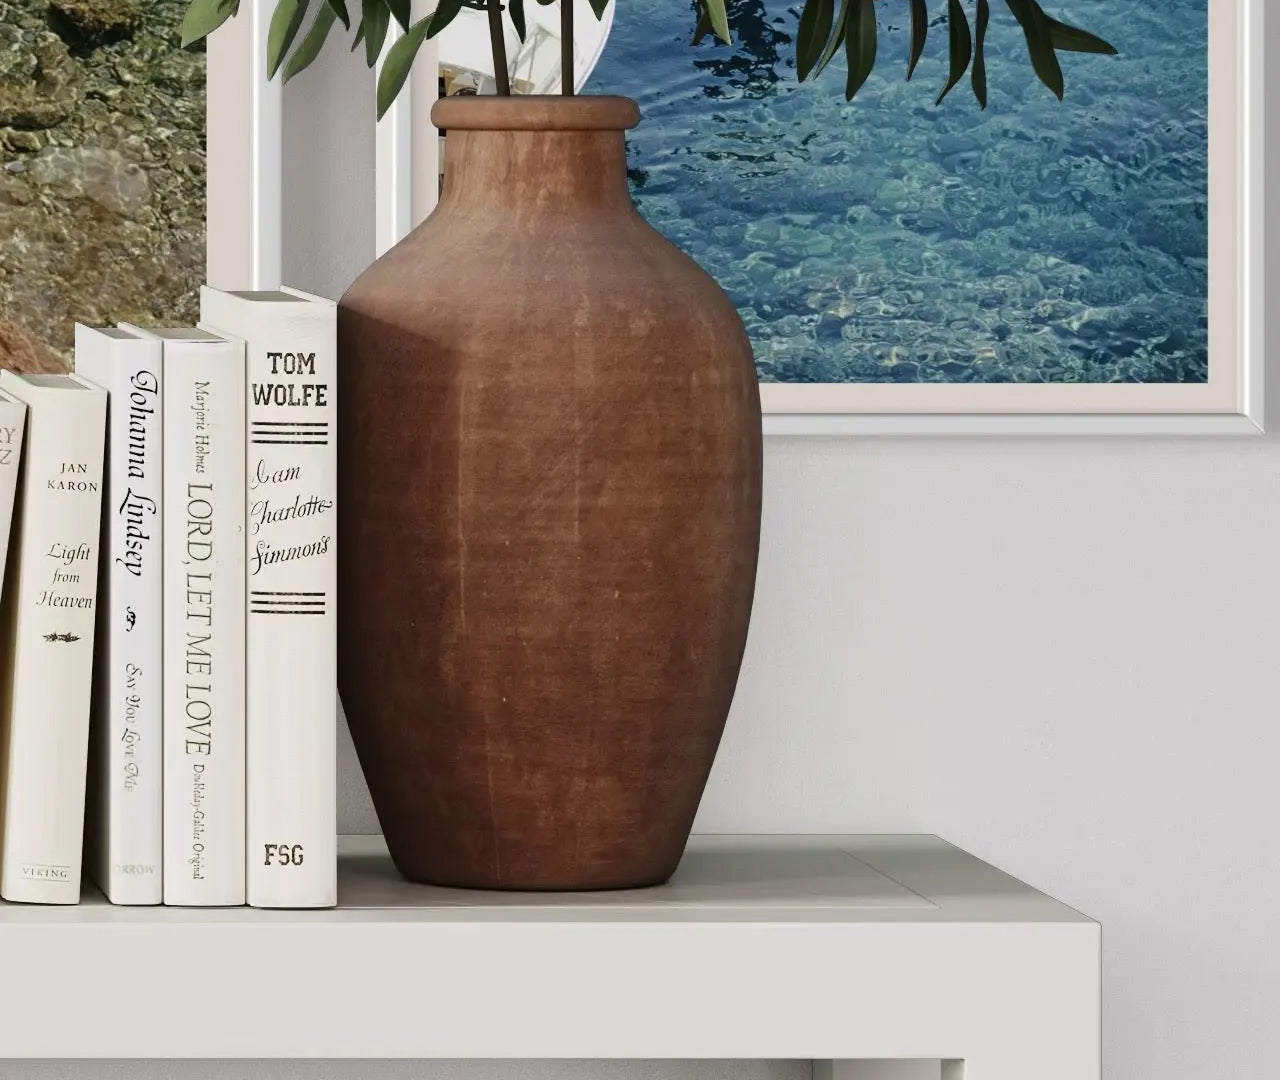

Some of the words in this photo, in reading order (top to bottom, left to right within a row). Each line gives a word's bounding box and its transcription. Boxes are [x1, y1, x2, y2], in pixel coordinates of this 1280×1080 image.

[266, 351, 316, 375] TOM
[190, 380, 211, 431] Marjorie
[251, 383, 328, 407] WOLFE
[127, 369, 159, 479] Johanna
[60, 462, 88, 474] JAN
[194, 434, 211, 474] Holmes
[47, 479, 99, 493] KARON
[272, 466, 301, 484] am
[115, 487, 157, 577] Lindsey
[182, 482, 214, 565] LORD,
[250, 494, 334, 538] Charlotte
[47, 542, 91, 566] Light
[250, 535, 331, 576] Simmons
[52, 567, 80, 585] from
[35, 591, 93, 610] Heaven
[186, 572, 213, 627] LET
[185, 632, 212, 676] ME
[185, 683, 212, 756] LOVE
[263, 843, 304, 866] FSG
[22, 867, 70, 878] VIKING
